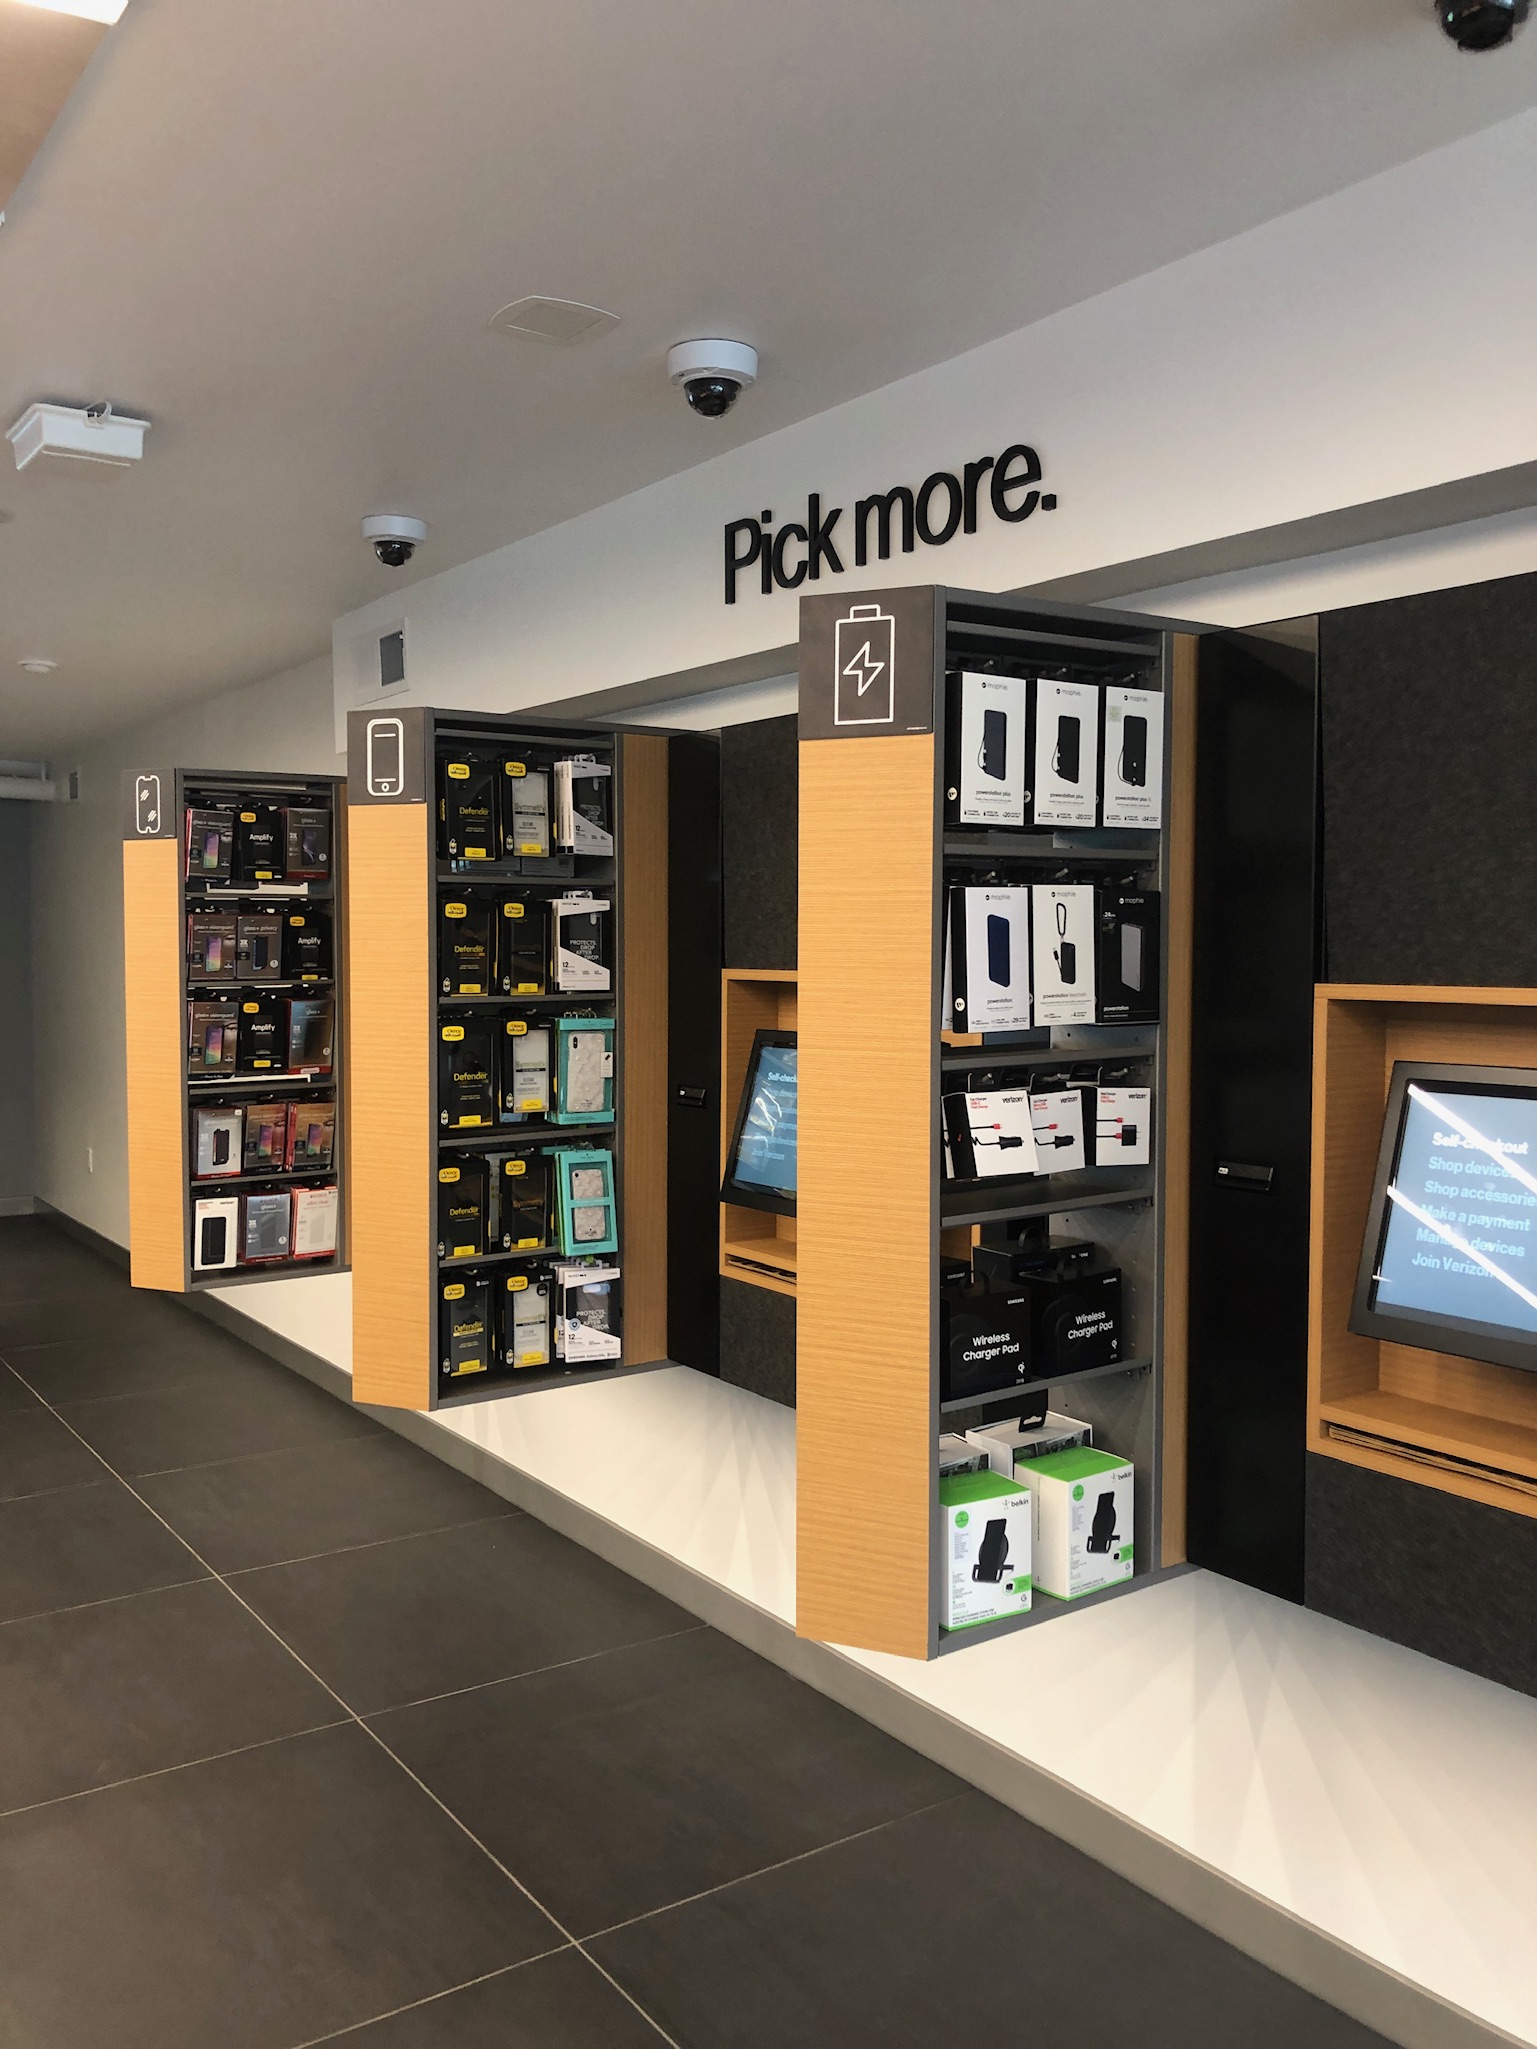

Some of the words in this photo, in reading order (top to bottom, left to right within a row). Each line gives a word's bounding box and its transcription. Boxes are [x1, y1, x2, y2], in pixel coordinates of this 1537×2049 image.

[725, 493, 845, 605] Pick
[855, 444, 1058, 568] more.
[459, 806, 489, 815] Defender
[249, 833, 274, 842] Amplify
[297, 936, 322, 945] Amplify
[454, 945, 485, 953] Defender
[251, 1024, 276, 1032] Amplify
[453, 1071, 488, 1081] Defender
[1002, 1095, 1024, 1104] verizon
[1060, 1095, 1078, 1104] verizon
[1428, 1156, 1463, 1174] Shop
[1424, 1180, 1459, 1198] Shop
[449, 1205, 479, 1216] Defender
[1457, 1212, 1467, 1223] a
[1468, 1213, 1531, 1232] payment
[1470, 1237, 1526, 1257] devices
[1412, 1252, 1440, 1269] Join
[1075, 1311, 1106, 1326] Wireless
[1067, 1325, 1099, 1340] Charger
[1098, 1320, 1114, 1332] Pad
[972, 1333, 1011, 1347] Wireless
[962, 1347, 1001, 1362] Charger
[1002, 1343, 1020, 1355] Pad
[1118, 1471, 1132, 1481] belkin
[1011, 1499, 1029, 1508] belkin
